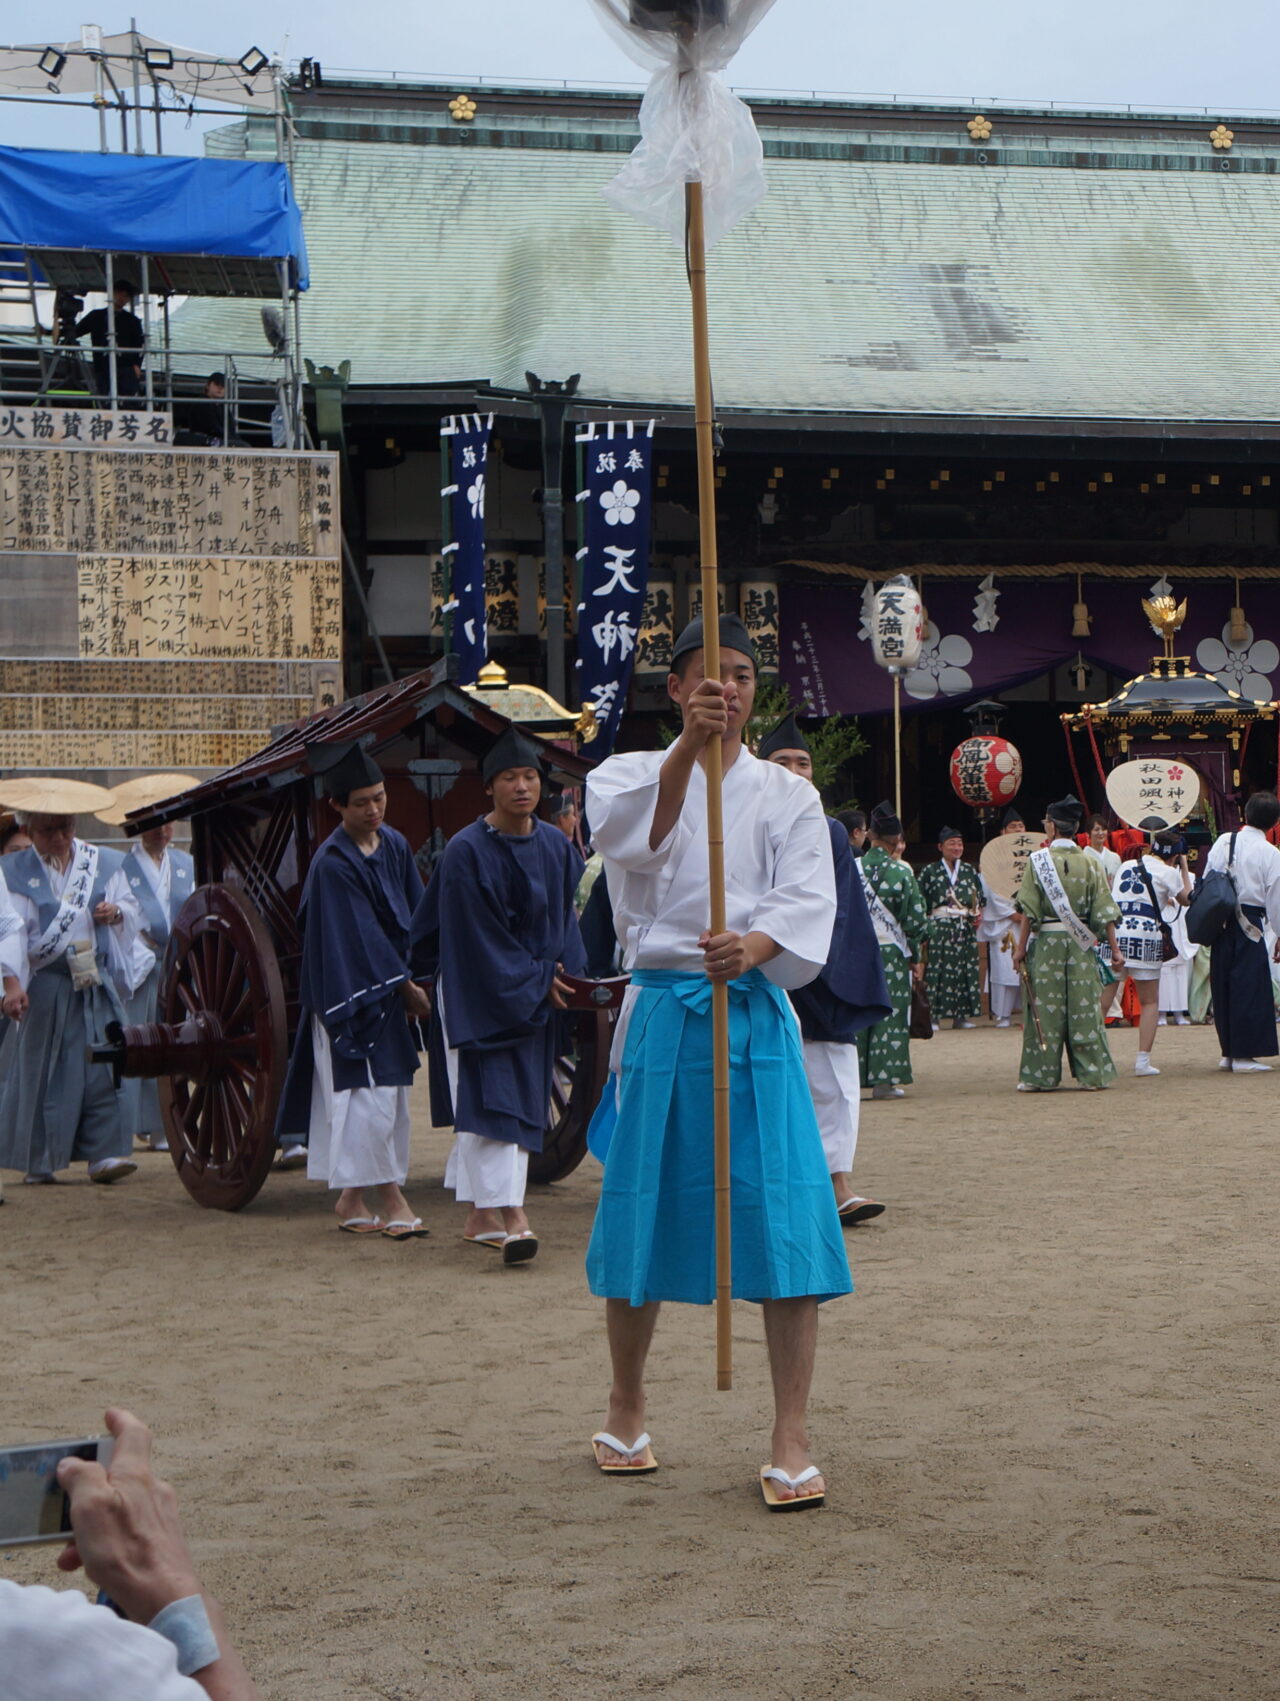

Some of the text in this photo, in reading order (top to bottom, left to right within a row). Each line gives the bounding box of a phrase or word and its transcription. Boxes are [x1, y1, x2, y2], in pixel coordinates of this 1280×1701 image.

[1, 410, 169, 443] 火協賛御芳名
[879, 591, 906, 660] 天満宮
